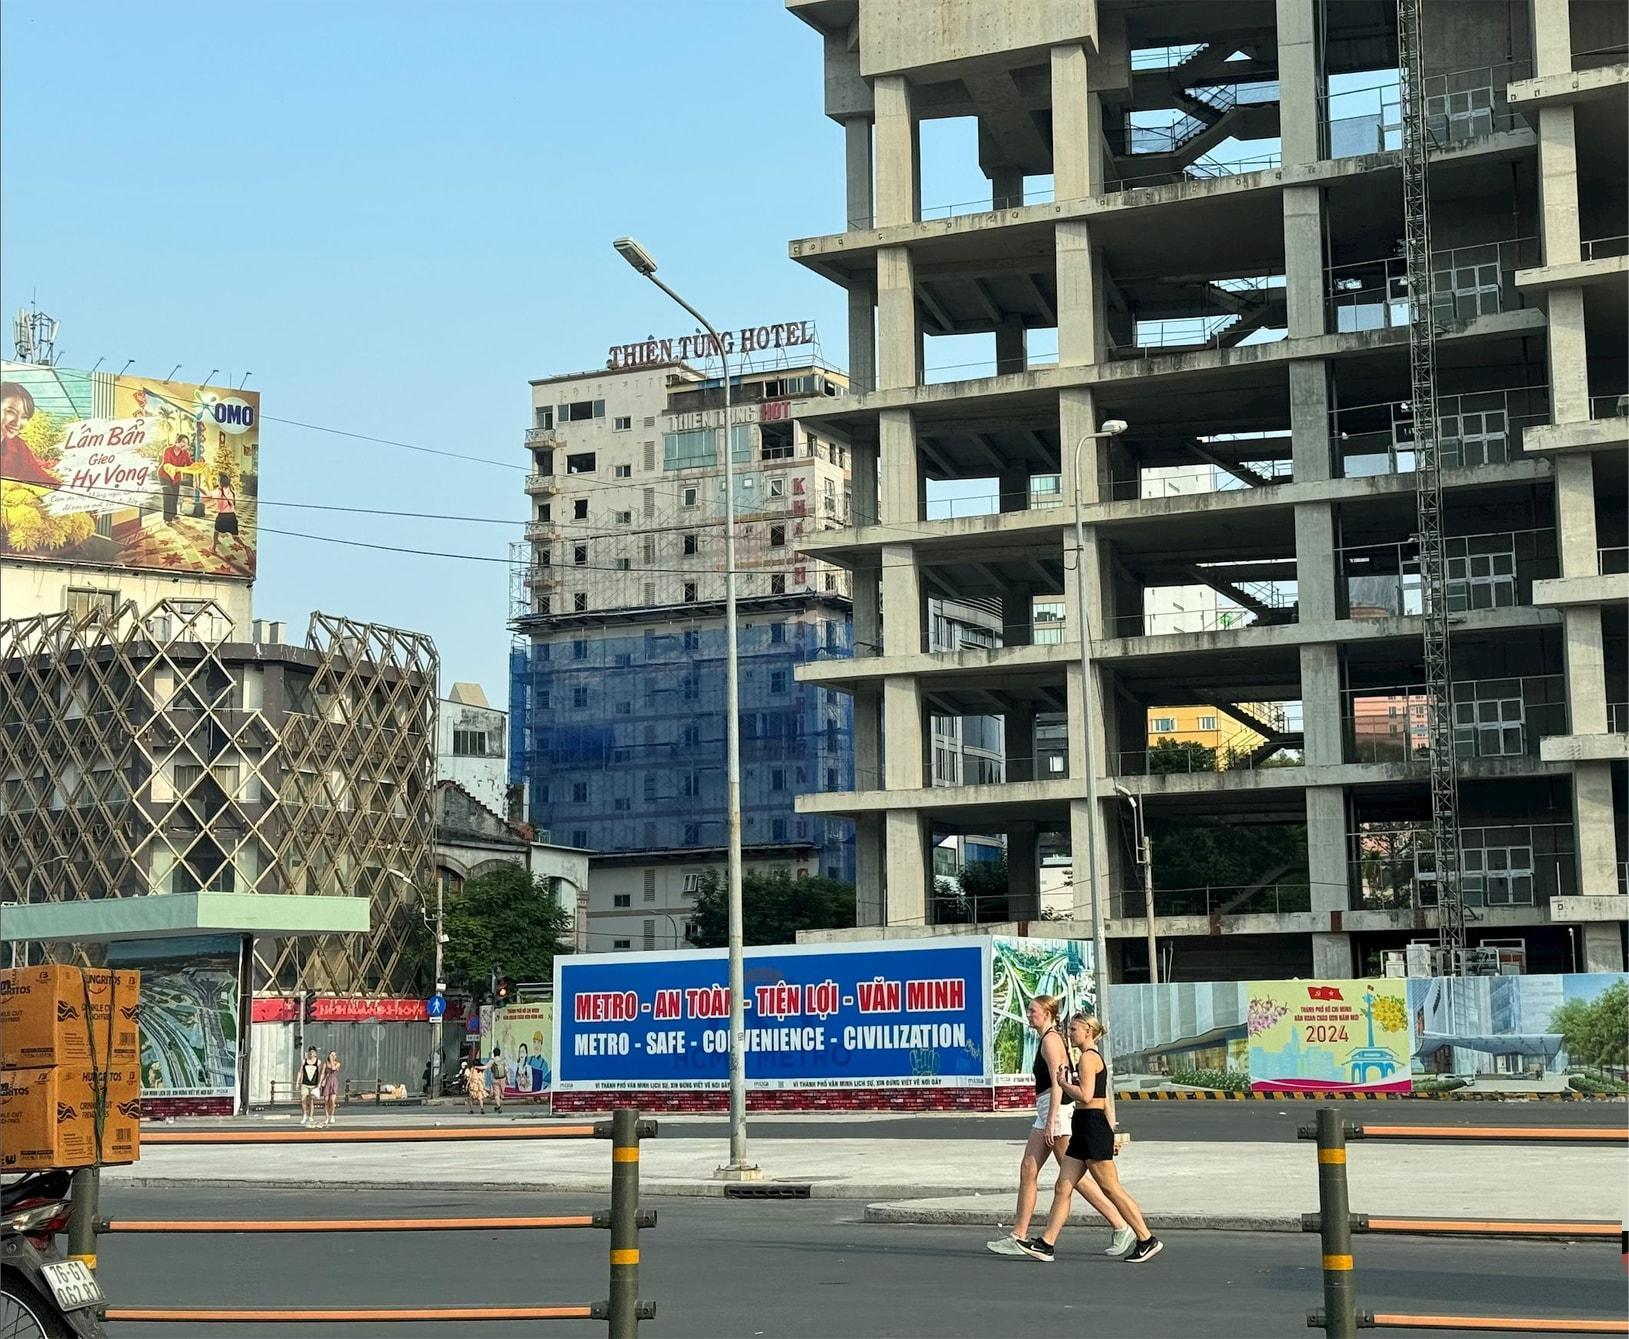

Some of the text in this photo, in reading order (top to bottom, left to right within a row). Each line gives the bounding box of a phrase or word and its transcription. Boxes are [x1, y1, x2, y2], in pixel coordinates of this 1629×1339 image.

[740, 320, 814, 352] HOTEL
[215, 403, 254, 426] OMO
[64, 419, 145, 449] Lấm Bẩn
[88, 453, 115, 466] Gieo
[71, 464, 149, 492] Hy Vọng
[575, 991, 638, 1022] METRO
[654, 990, 682, 1020] AN
[686, 984, 730, 1019] TOÀ
[756, 980, 801, 1021] TIỆN
[806, 979, 839, 1020] LỢI
[856, 976, 901, 1014] VĂN
[906, 978, 965, 1012] MINH
[574, 1032, 629, 1056] METRO
[646, 1031, 685, 1054] SAFE
[844, 1023, 965, 1050] CIVILIZATION
[1306, 1025, 1349, 1042] 2024
